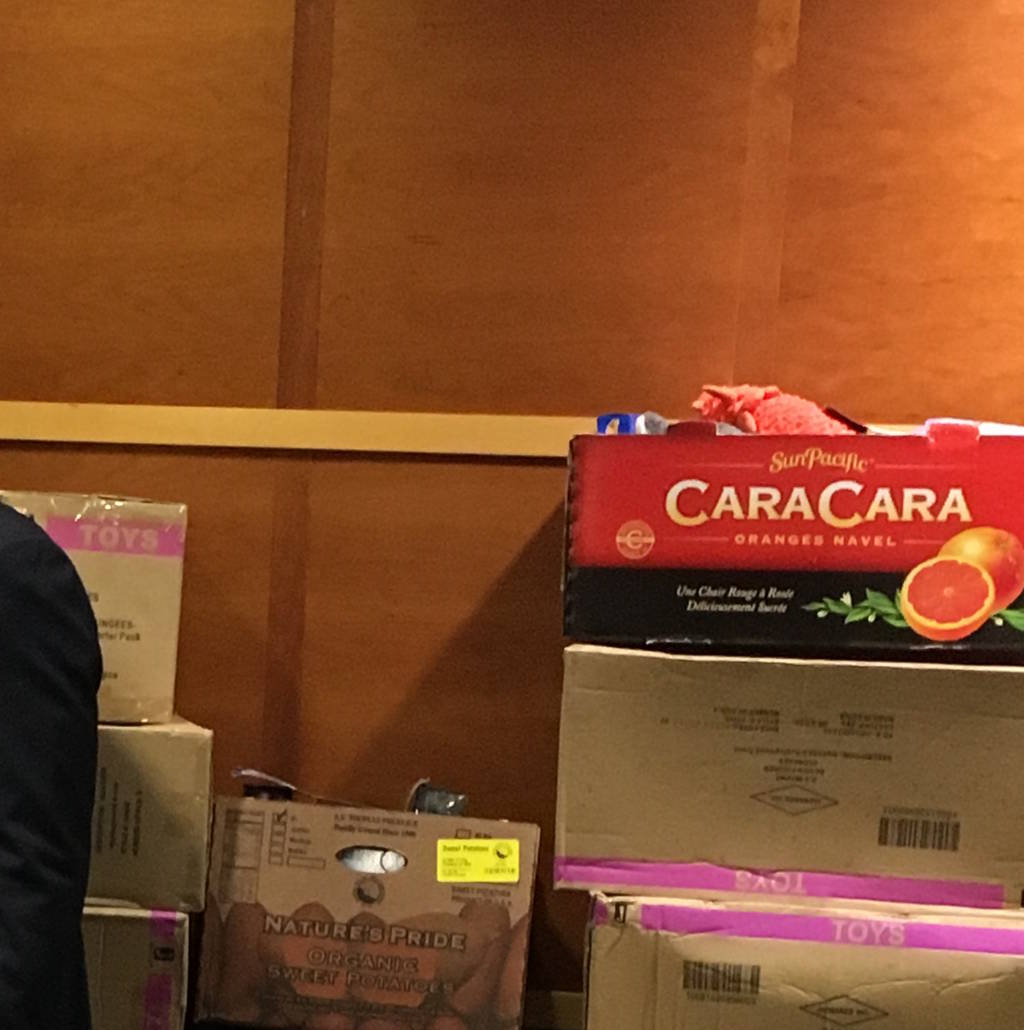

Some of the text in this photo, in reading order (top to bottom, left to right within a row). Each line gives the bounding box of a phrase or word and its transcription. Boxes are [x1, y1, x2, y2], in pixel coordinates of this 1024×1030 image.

[769, 447, 868, 473] SunPacific
[79, 524, 159, 549] TOYS
[734, 533, 897, 547] ORANGES NAVEL
[734, 871, 806, 895] TOYS
[390, 926, 465, 950] PRIDE
[832, 919, 906, 946] TOYS
[308, 949, 419, 974] ORGANIC
[268, 966, 454, 993] SWEET POTATOES
